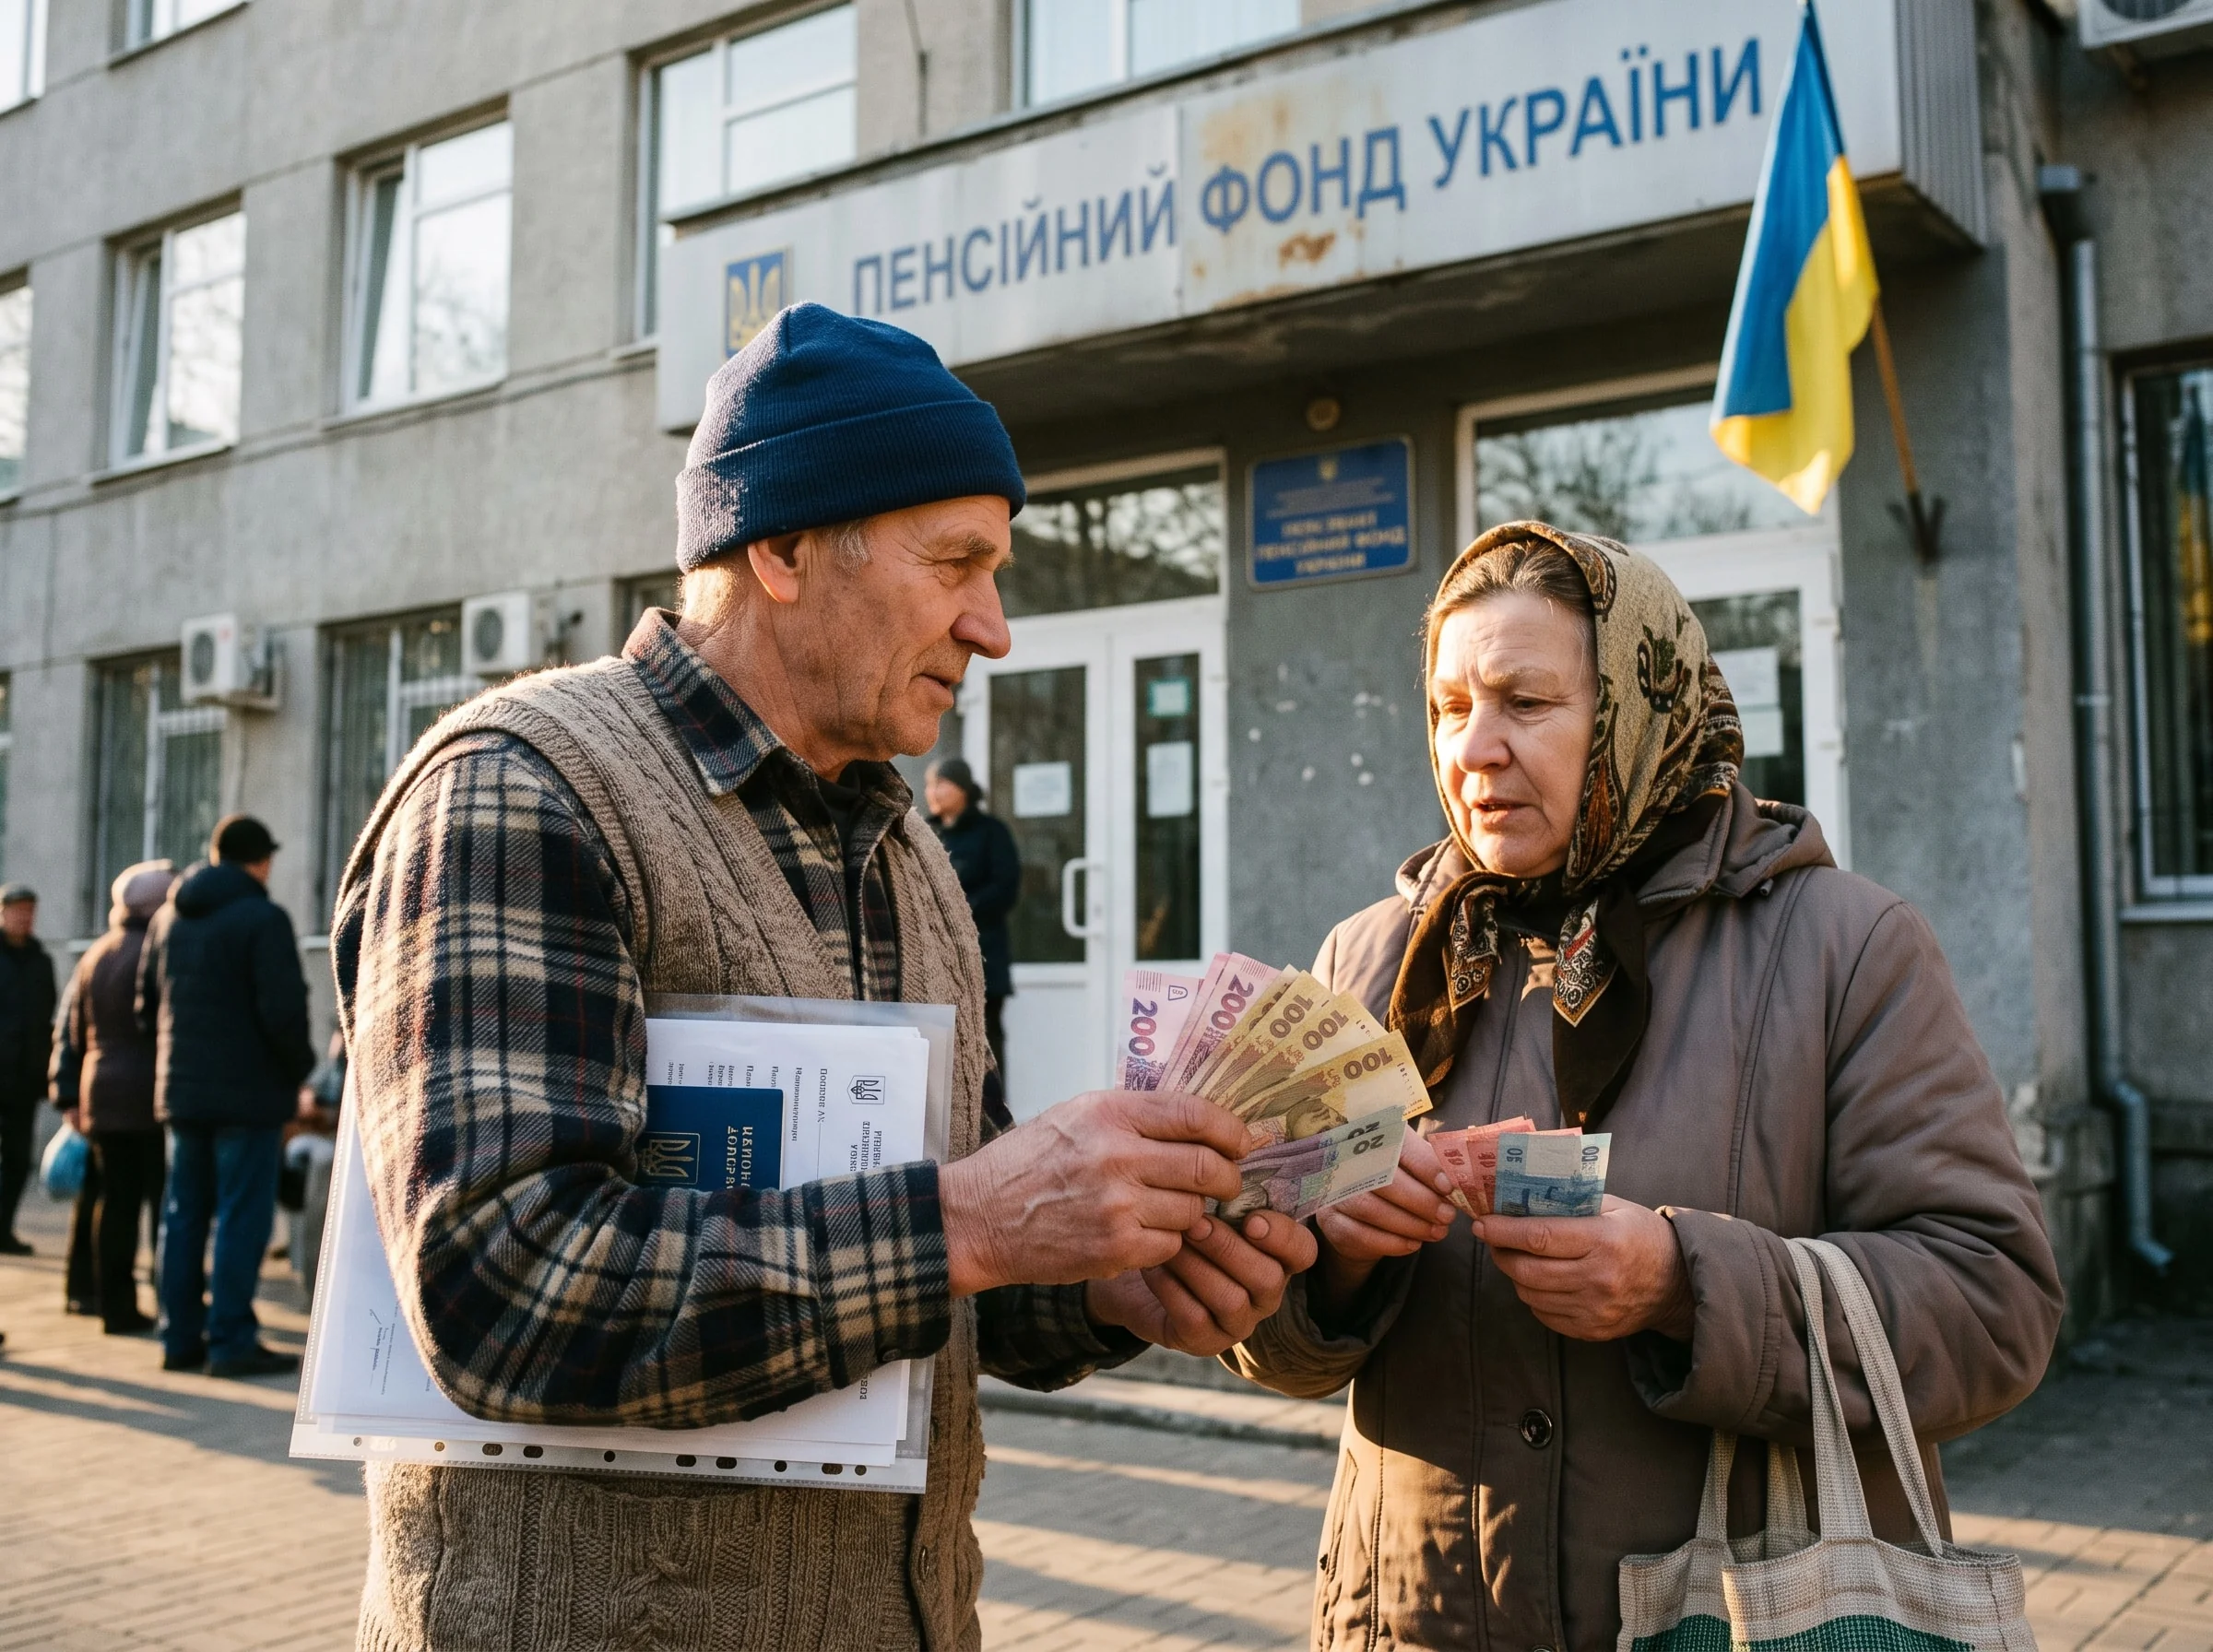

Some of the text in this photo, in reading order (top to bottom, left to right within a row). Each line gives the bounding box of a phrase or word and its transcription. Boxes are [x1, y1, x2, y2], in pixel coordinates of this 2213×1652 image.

[854, 36, 1763, 316] ПЕНСІЙНИЙ ФОНД УКРАЇНИ
[1211, 974, 1255, 1031] 200
[1269, 994, 1314, 1039] 100
[1129, 997, 1158, 1056] 200
[1302, 1009, 1349, 1051] 100
[1343, 1047, 1393, 1080] 100
[1354, 1134, 1385, 1155] 20
